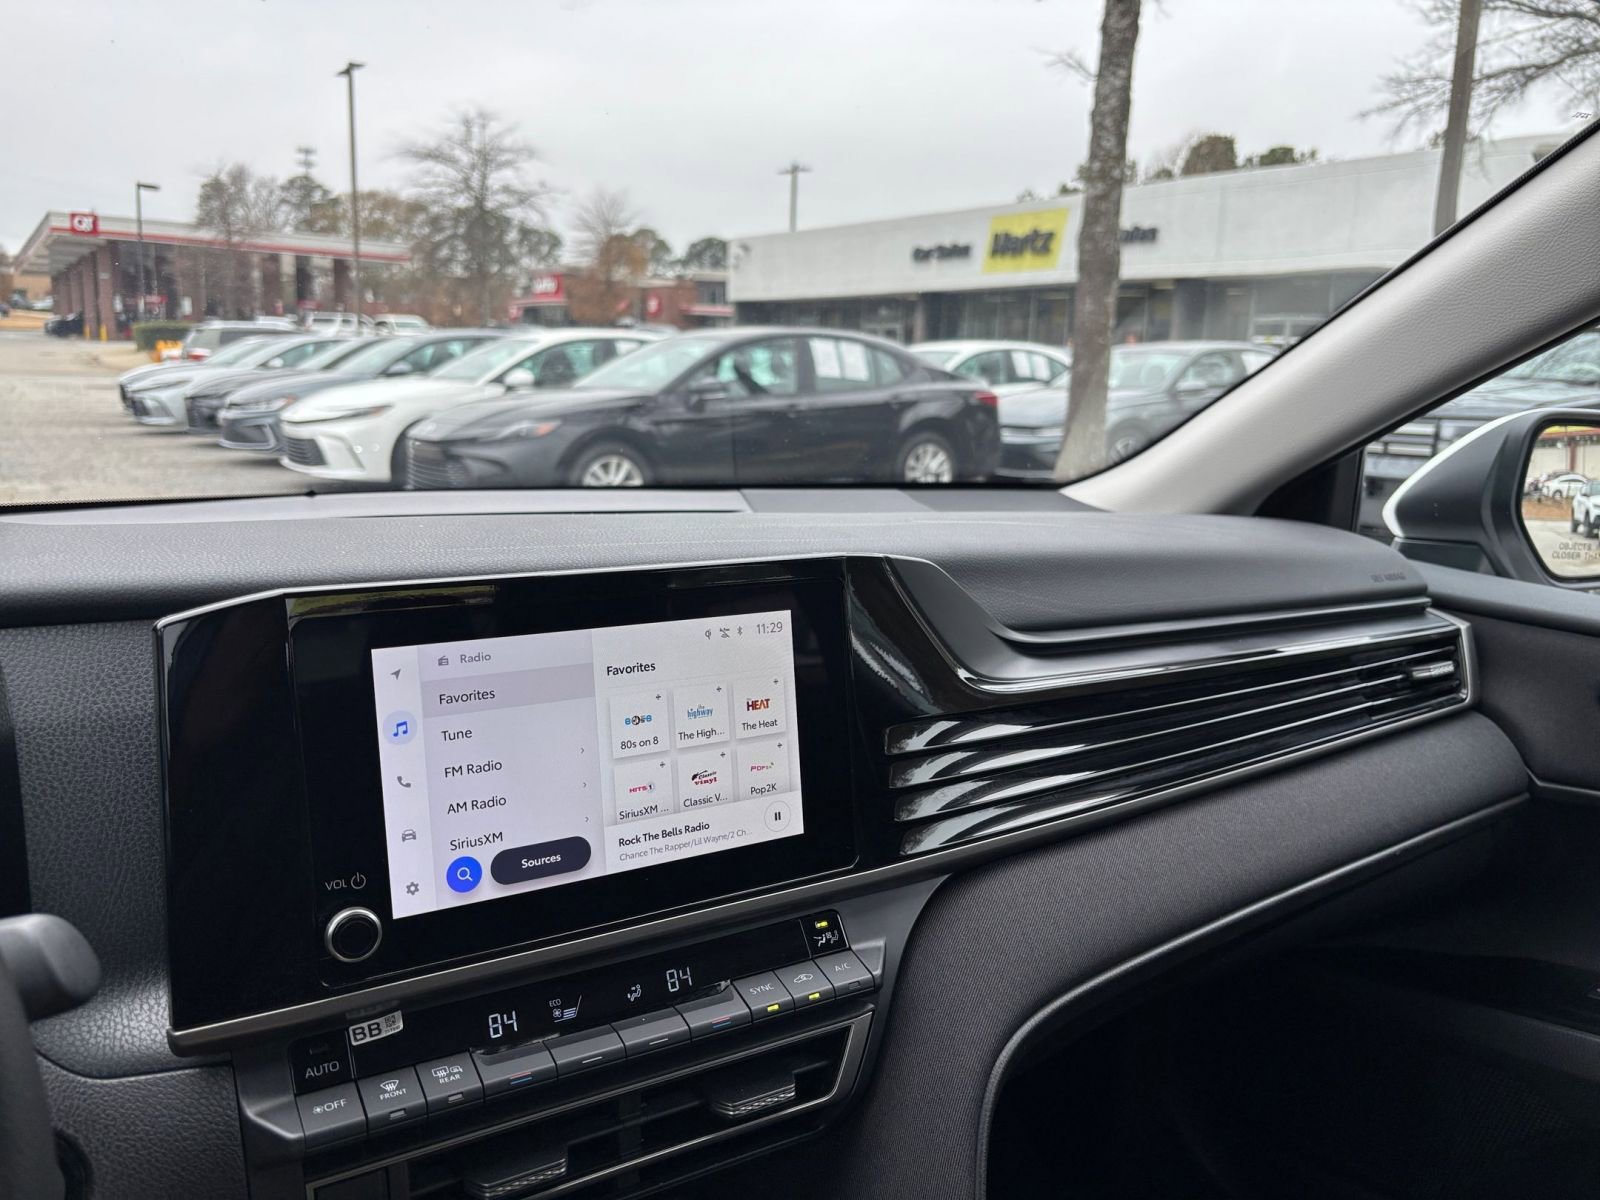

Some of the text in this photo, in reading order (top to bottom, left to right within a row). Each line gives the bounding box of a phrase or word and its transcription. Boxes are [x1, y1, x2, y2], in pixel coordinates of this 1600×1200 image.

[1558, 541, 1592, 551] OBJECTS
[1551, 550, 1581, 560] CLOSER
[757, 621, 783, 634] 11:29
[460, 652, 491, 664] Radio
[606, 661, 656, 676] Favorites
[439, 688, 496, 705] Favorites
[746, 698, 770, 711] HEAT
[742, 718, 778, 731] The Heat
[441, 728, 473, 742] Tune
[678, 731, 695, 741] The
[620, 736, 659, 750] 80s on 8
[444, 760, 503, 778] FM Radio
[751, 782, 777, 796] Pop2K
[447, 795, 507, 815] AM Radio
[683, 795, 713, 808] Classic
[619, 804, 659, 820] SiriusXM
[450, 831, 504, 851] SiriusXM
[618, 821, 710, 847] Rock The Bells Radio
[521, 853, 562, 868] Sources
[619, 850, 648, 862] Chance
[649, 847, 663, 856] The
[324, 878, 348, 891] VOL
[834, 962, 852, 973] A/C
[666, 966, 693, 993] 84
[750, 983, 775, 995] SYNC
[549, 998, 562, 1008] ECO
[488, 1010, 518, 1039] 84
[352, 1022, 382, 1043] BB
[305, 1060, 340, 1079] AUTO
[439, 1073, 461, 1084] REAR
[379, 1088, 407, 1100] FRONT
[324, 1098, 348, 1112] OFF
